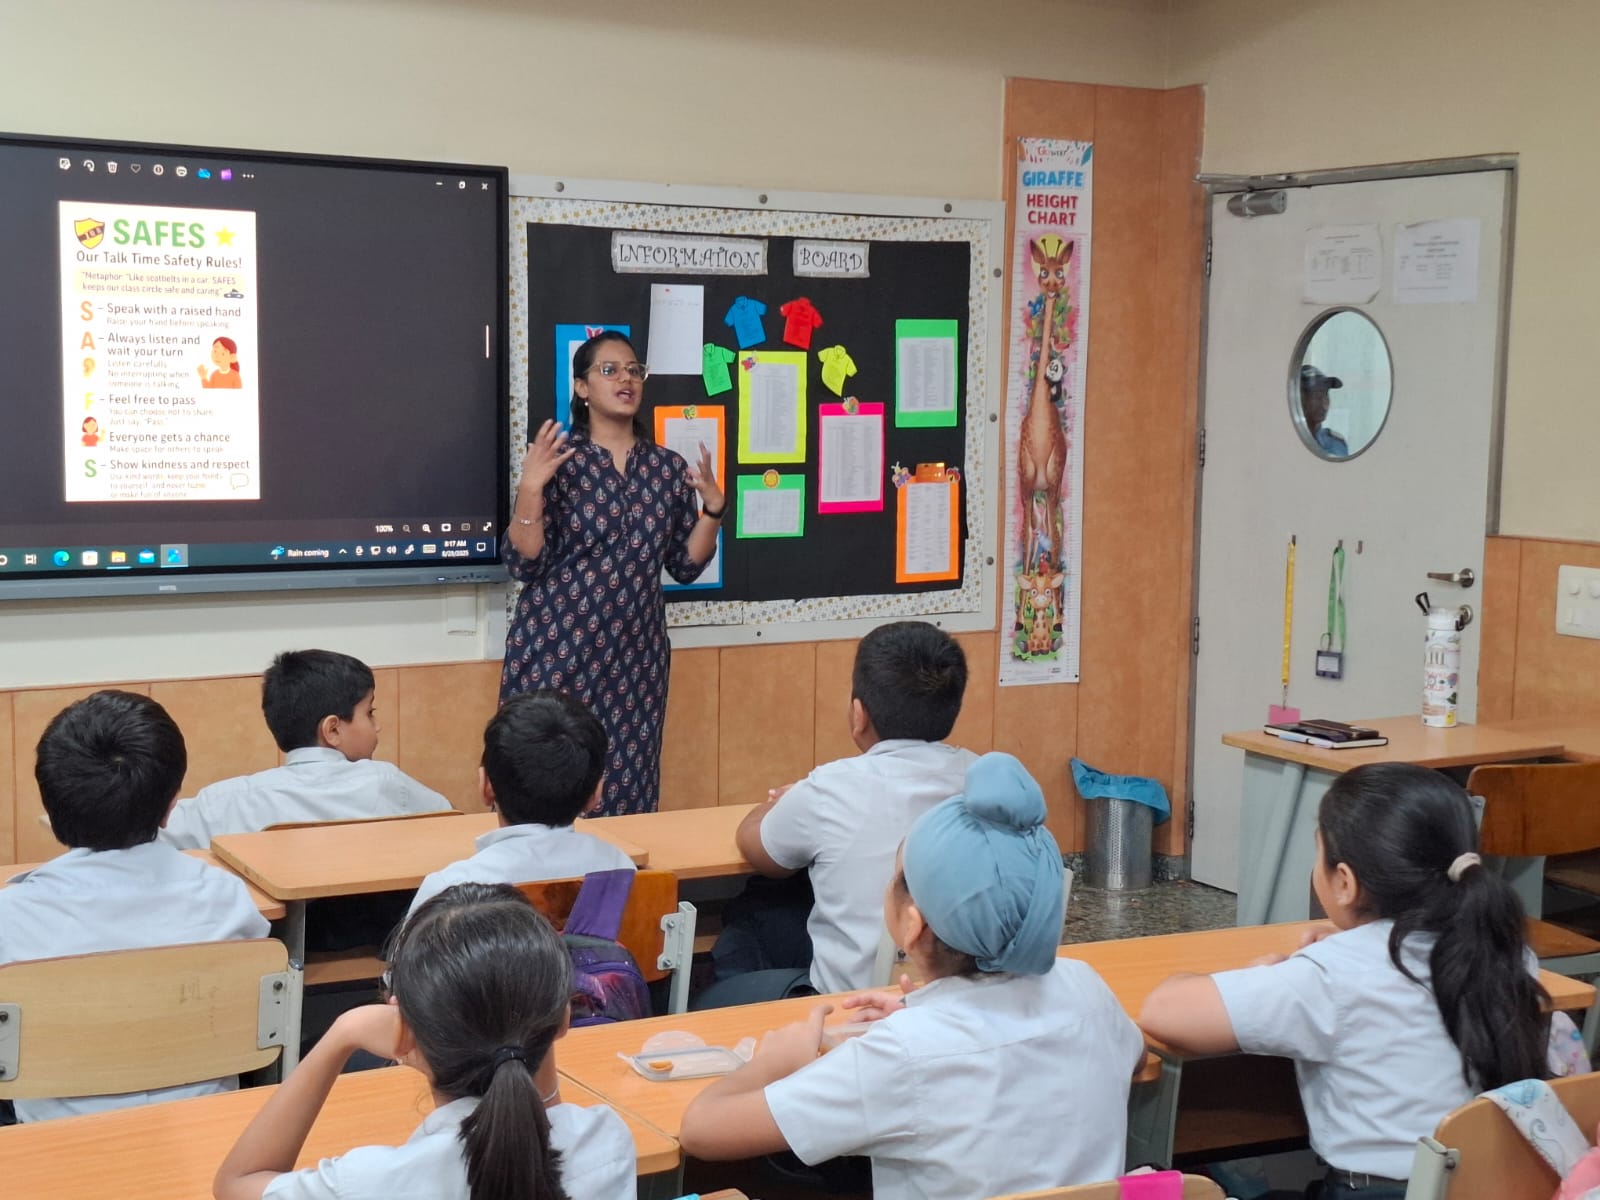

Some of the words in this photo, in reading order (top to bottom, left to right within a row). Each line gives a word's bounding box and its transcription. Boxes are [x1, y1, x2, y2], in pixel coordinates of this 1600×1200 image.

[1022, 171, 1084, 187] GIRAFFE
[1026, 194, 1078, 209] HEIGHT
[1028, 210, 1076, 226] CHART
[113, 219, 205, 248] SAFES
[77, 251, 99, 262] Our
[104, 251, 127, 264] Talk
[132, 252, 160, 265] Time
[164, 254, 202, 270] Safety
[206, 256, 242, 268] Rules!
[618, 244, 760, 269] INFORMATION
[800, 247, 863, 272] BOARD
[182, 275, 189, 283] in
[212, 277, 236, 285] SAFES
[83, 283, 104, 293] keeps
[121, 285, 139, 293] class
[142, 285, 162, 293] circle
[165, 286, 179, 294] safe
[181, 286, 194, 294] and
[80, 301, 93, 321] S
[108, 303, 140, 314] Speak
[144, 304, 167, 314] with
[180, 306, 212, 316] raised
[215, 307, 241, 317] hand
[149, 318, 167, 326] hand
[170, 319, 194, 327] before
[80, 331, 96, 350] A
[108, 332, 146, 345] Always
[149, 333, 178, 344] listen
[181, 335, 200, 345] and
[108, 347, 130, 356] wait
[134, 348, 157, 358] your
[160, 348, 183, 357] turn
[84, 392, 94, 411] F
[109, 394, 130, 404] Feel
[134, 394, 155, 404] free
[158, 395, 169, 404] to
[172, 397, 196, 406] pass
[110, 432, 157, 444] Everyone
[161, 433, 183, 444] gets
[194, 432, 230, 442] chance
[84, 459, 97, 478] S
[110, 460, 138, 469] Show
[142, 459, 187, 469] kindness
[190, 460, 210, 469] and
[212, 460, 250, 471] respect
[376, 525, 394, 533] 100%
[288, 549, 302, 557] Rain
[304, 548, 330, 558] coming
